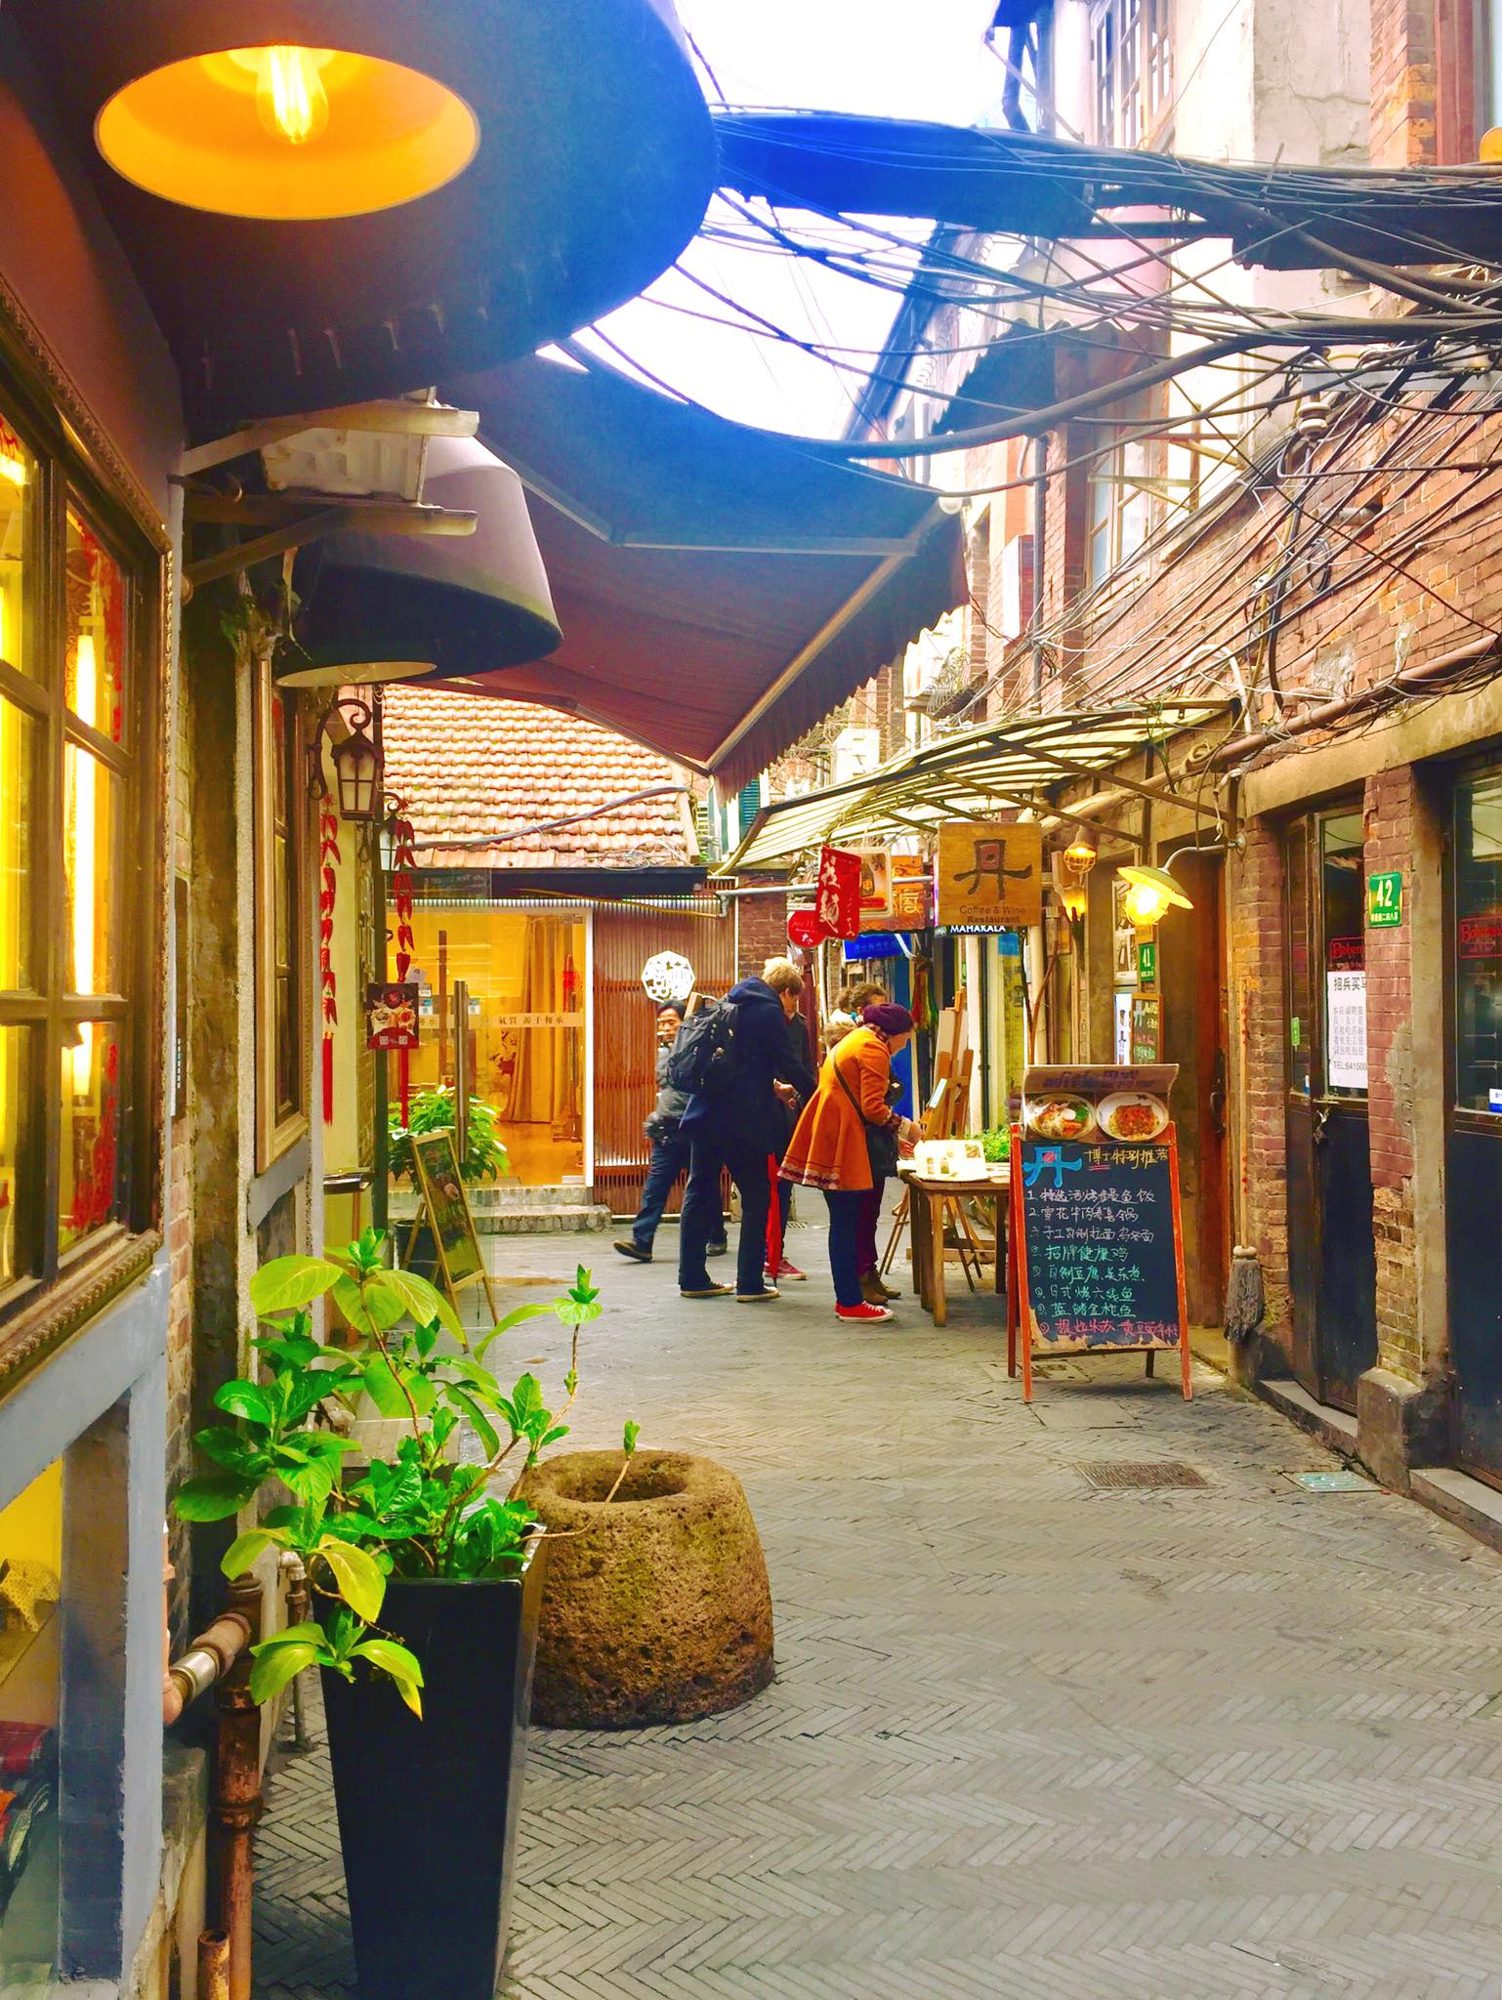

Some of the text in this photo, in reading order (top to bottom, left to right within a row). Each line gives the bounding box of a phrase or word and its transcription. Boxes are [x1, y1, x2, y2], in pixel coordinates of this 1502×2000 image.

[1376, 879, 1393, 907] 42
[959, 904, 991, 915] Coffee
[993, 905, 1000, 915] &
[967, 915, 1020, 924] Restaurant
[950, 925, 1006, 933] MAHAKALA
[1142, 947, 1151, 967] 41
